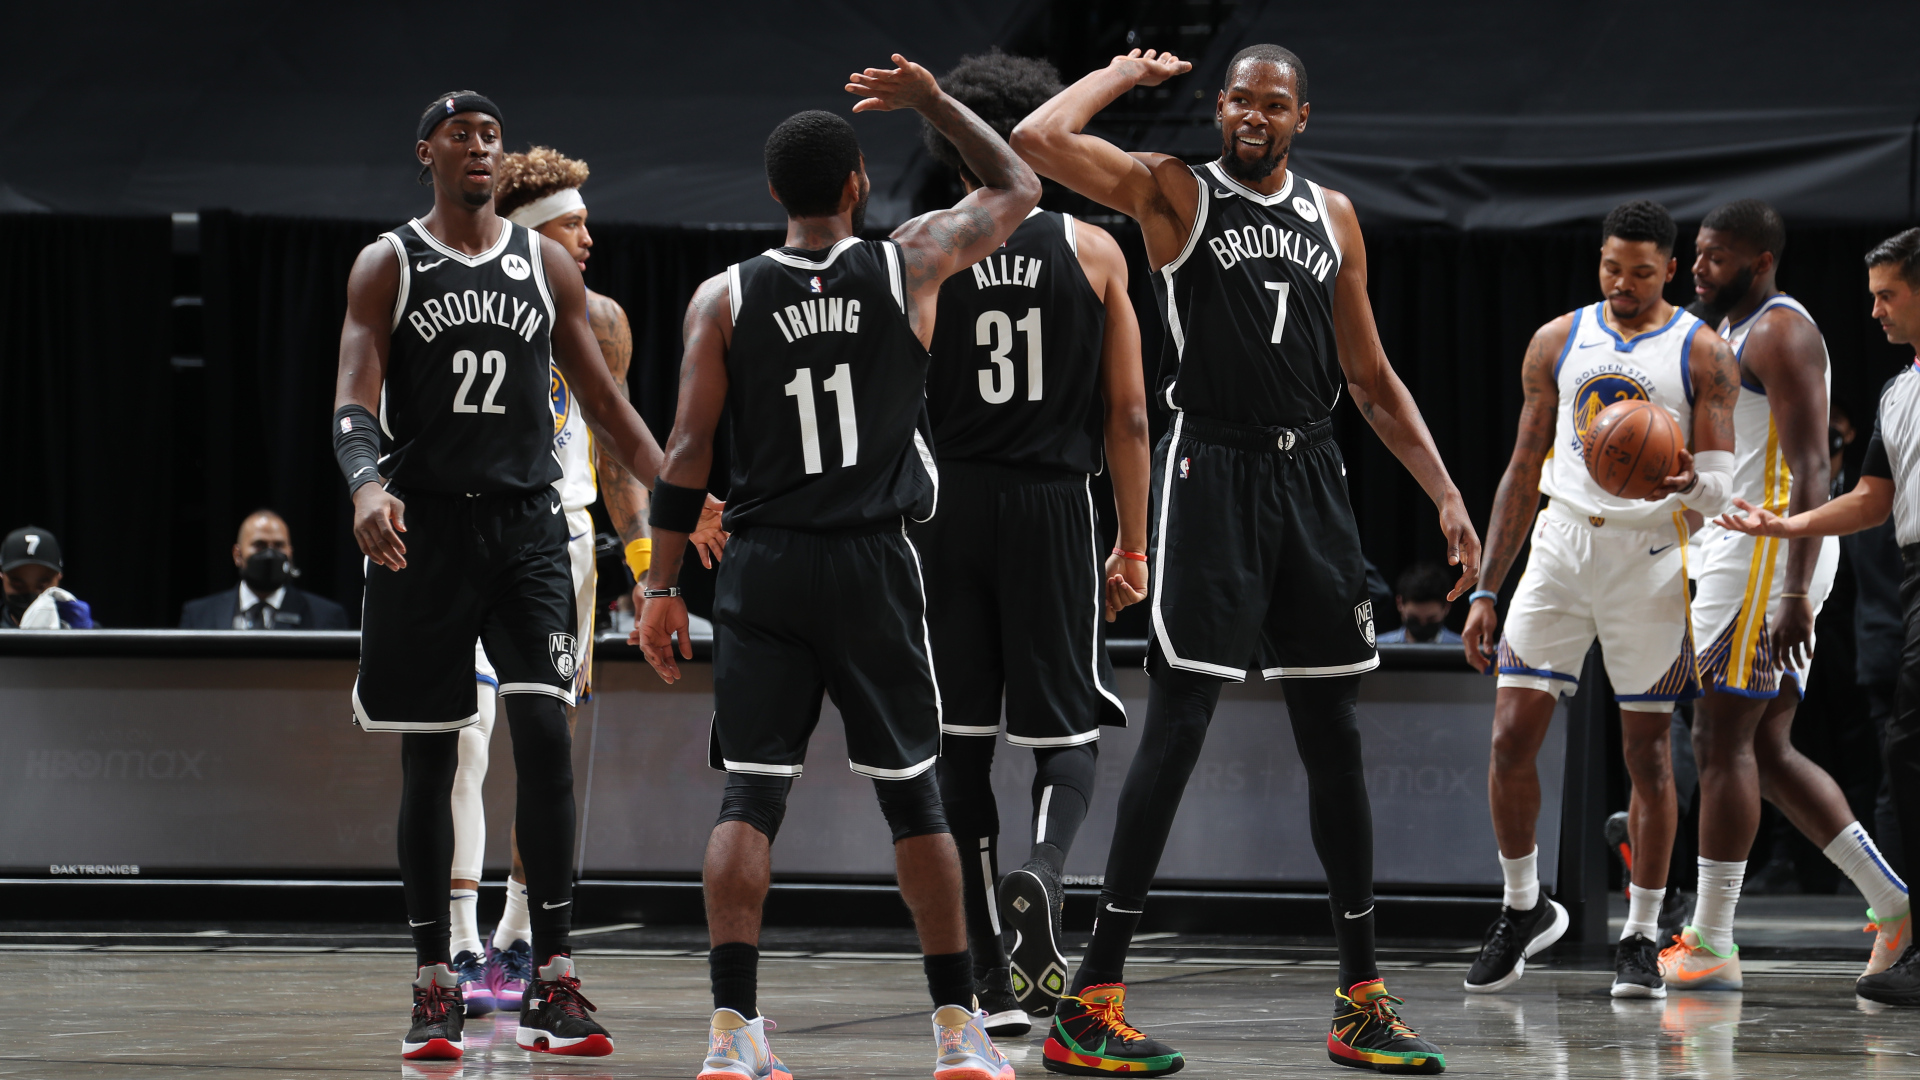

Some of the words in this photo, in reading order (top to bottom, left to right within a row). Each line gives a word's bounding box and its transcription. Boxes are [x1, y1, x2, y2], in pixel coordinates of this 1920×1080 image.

[971, 254, 1043, 290] ALLEN
[1208, 224, 1334, 283] BROOKLYN
[408, 290, 543, 343] BROOKLYN
[773, 297, 861, 343] IRVING
[1264, 280, 1290, 344] 7
[975, 307, 1043, 404] 31
[1575, 364, 1623, 386] GOLDEN
[1628, 367, 1657, 394] STATE
[452, 350, 507, 414] 22
[784, 363, 858, 475] 11
[24, 534, 41, 555] 7
[551, 635, 578, 660] NETS
[49, 864, 140, 875] DAKTRONICS
